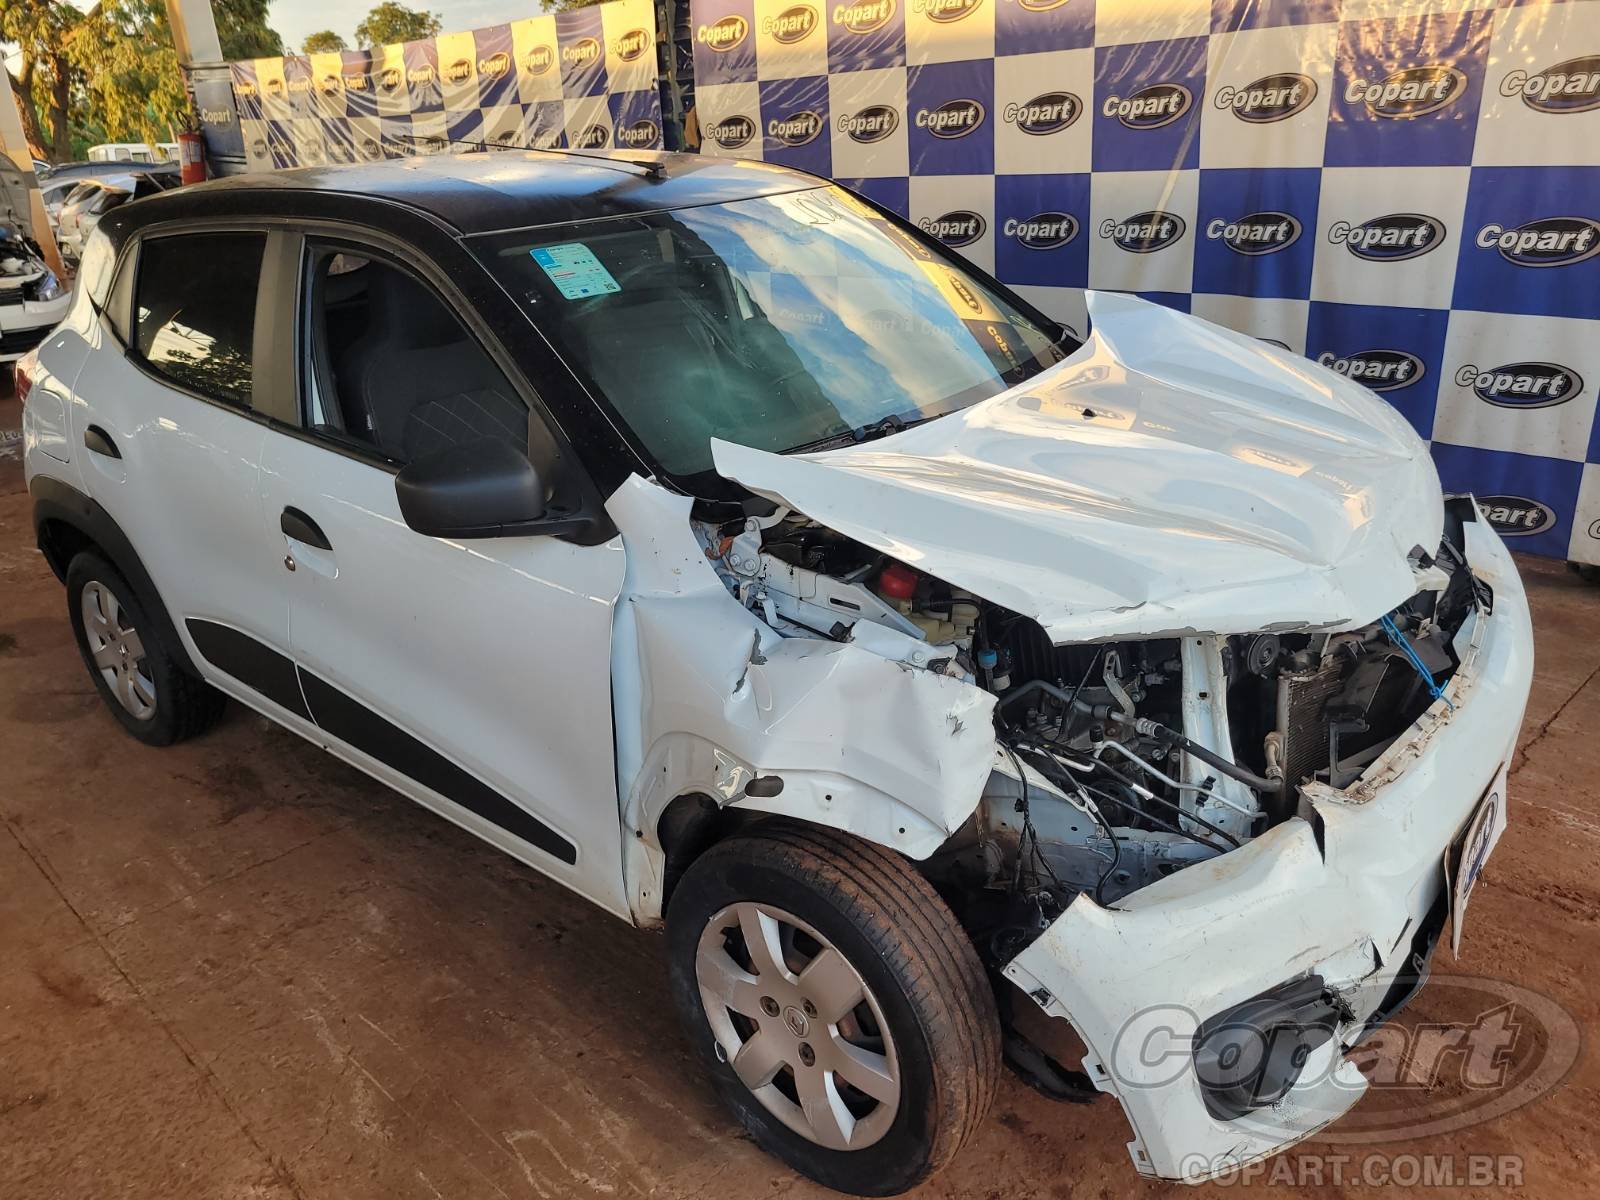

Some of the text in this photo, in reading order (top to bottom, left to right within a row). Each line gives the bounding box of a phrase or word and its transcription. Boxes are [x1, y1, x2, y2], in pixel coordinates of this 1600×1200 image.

[762, 10, 811, 36] Copart
[833, 1, 887, 25] Copart
[697, 22, 742, 44] Copart
[563, 42, 596, 61] Copart
[480, 56, 507, 75] Copart
[1214, 84, 1301, 111] Copart
[1344, 73, 1452, 109] Copart
[1499, 69, 1600, 102] Copar
[201, 108, 231, 125] Copart
[1003, 100, 1071, 126] Copart
[1103, 90, 1180, 119] Copart
[706, 120, 748, 141] Copart
[768, 118, 815, 141] Copart
[837, 113, 889, 138] Copart
[916, 107, 975, 130] Copart
[618, 125, 653, 144] Copart
[919, 216, 977, 240] Copart
[1004, 214, 1070, 240] Copart
[1100, 216, 1172, 243] Copart
[1206, 218, 1290, 245] Copart
[1328, 220, 1430, 250] Copart
[1476, 222, 1594, 256] Copart
[1317, 351, 1412, 380] Copart
[1455, 364, 1566, 398] Copart
